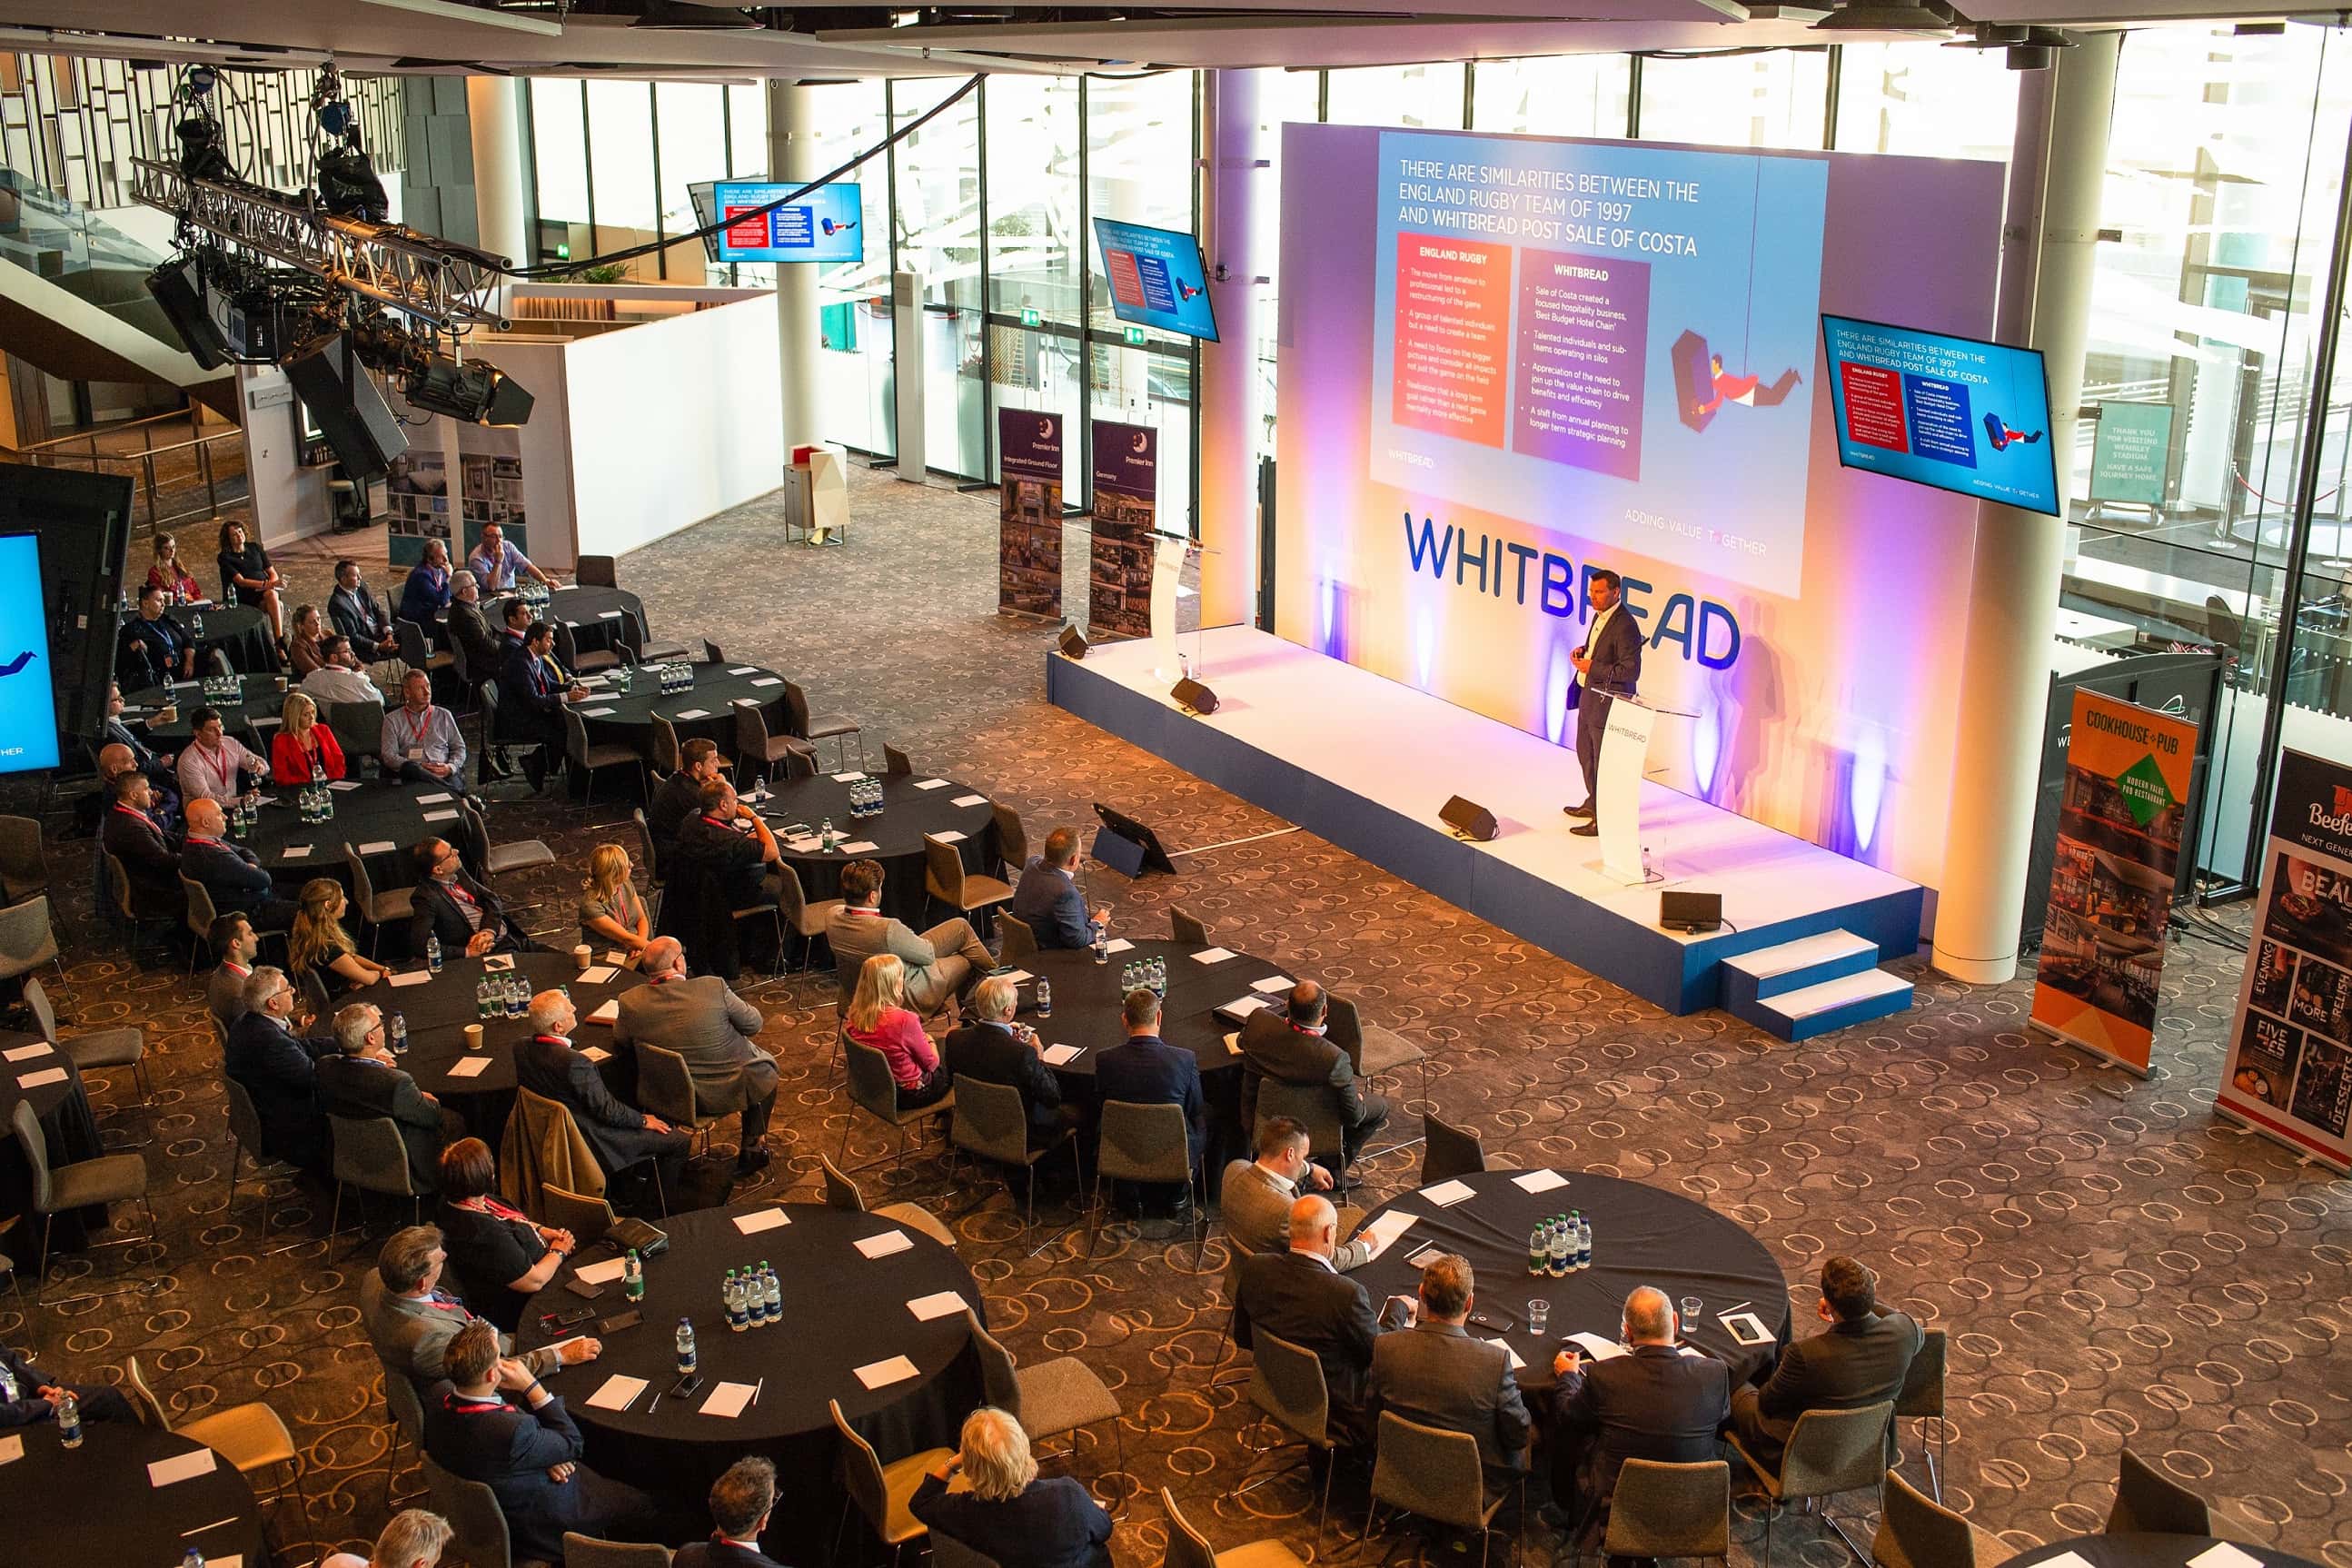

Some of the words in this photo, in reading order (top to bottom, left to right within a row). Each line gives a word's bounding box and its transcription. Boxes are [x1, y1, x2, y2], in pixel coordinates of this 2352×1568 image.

[1400, 159, 1444, 179] THERE
[1447, 164, 1476, 183] ARE
[1480, 166, 1574, 192] SIMILARITIES
[1579, 174, 1660, 199] BETWEEN
[1665, 181, 1700, 203] THE
[1399, 183, 1465, 205] ENGLAND
[1469, 189, 1519, 211] RUGBY
[1523, 194, 1565, 216] TEAM
[1570, 199, 1592, 218] OF
[1597, 202, 1632, 223] 1997
[1398, 206, 1427, 224] AND
[1432, 208, 1517, 234] WHITBREAD
[1522, 219, 1562, 241] POST
[1565, 223, 1606, 246] SALE
[1611, 228, 1634, 248] OF
[1639, 231, 1697, 257] COSTA
[1420, 246, 1458, 260] ENGLAND
[1460, 252, 1487, 265] RUGBY
[1554, 264, 1609, 282] WHITBREAD
[1535, 286, 1549, 296] Sale
[1551, 289, 1557, 297] of
[1559, 290, 1577, 300] Costa
[1579, 293, 1603, 303] created
[1535, 298, 1560, 310] focused
[1562, 303, 1594, 317] hospitality
[1596, 308, 1627, 321] business,
[1552, 313, 1575, 325] Budget
[1576, 318, 1594, 327] Hotel
[1533, 329, 1562, 342] Talented
[1563, 334, 1596, 349] individuals
[1598, 342, 1611, 351] and
[1837, 329, 1860, 342] THERE
[1862, 334, 1877, 343] ARE
[1879, 337, 1927, 352] SIMILARITIES
[1928, 345, 1968, 361] BETWEEN
[1969, 353, 1986, 364] THE
[1533, 343, 1552, 353] teams
[1553, 347, 1584, 361] operating
[1593, 354, 1608, 363] silos
[1837, 340, 1872, 352] ENGLAND
[1875, 346, 1900, 358] RUGBY
[1903, 351, 1924, 362] TEAM
[1926, 356, 1938, 364] OF
[1939, 358, 1956, 368] 1997
[1533, 362, 1573, 377] Appreciation
[1583, 372, 1593, 382] the
[1594, 375, 1611, 385] need
[1613, 378, 1620, 387] to
[1839, 349, 1854, 359] AND
[1856, 352, 1901, 368] WHITBREAD
[1903, 361, 1923, 372] POST
[1926, 365, 1945, 377] SALE
[1947, 369, 1960, 378] OF
[1960, 372, 1990, 385] COSTA
[1531, 386, 1556, 399] benefits
[1557, 392, 1570, 401] and
[1571, 395, 1602, 410] efficiency
[1544, 378, 1553, 386] up
[1554, 379, 1564, 388] the
[1566, 382, 1583, 392] value
[1584, 385, 1602, 395] chain
[1604, 390, 1611, 398] to
[1613, 391, 1630, 402] drive
[1530, 406, 1535, 414] A
[1537, 408, 1551, 418] shift
[1552, 411, 1567, 422] from
[1569, 415, 1590, 426] annual
[1591, 420, 1620, 434] planning
[1621, 427, 1628, 435] to
[2112, 427, 2137, 435] THANK
[1530, 418, 1550, 431] longer
[1551, 423, 1566, 433] term
[1568, 427, 1595, 441] strategic
[1597, 433, 1625, 449] planning
[1032, 442, 1050, 452] Premier
[1051, 444, 1060, 452] Inn
[1004, 456, 1027, 465] Integrated
[1027, 458, 1045, 467] Ground
[1045, 461, 1058, 469] Floor
[1126, 455, 1145, 466] Premier
[1145, 458, 1154, 467] Inn
[1096, 471, 1116, 481] Germany
[1625, 509, 1664, 530] ADDING
[1668, 520, 1702, 540] VALUE
[1608, 723, 1646, 743] WHITBREAD
[2087, 710, 2149, 745] COOKHOUSE
[2157, 732, 2178, 755] PUB
[2122, 785, 2132, 795] PUB
[2135, 787, 2166, 807] RESTAURANT
[2127, 776, 2149, 789] MODERN
[2150, 782, 2164, 795] VALUE
[2301, 833, 2324, 848] NEXT
[2256, 943, 2272, 995] EVENING
[2332, 974, 2350, 1018] RELISH
[2293, 998, 2328, 1024] MORE
[2258, 1019, 2287, 1044] FIVE
[2332, 1055, 2352, 1127] DESSERTS
